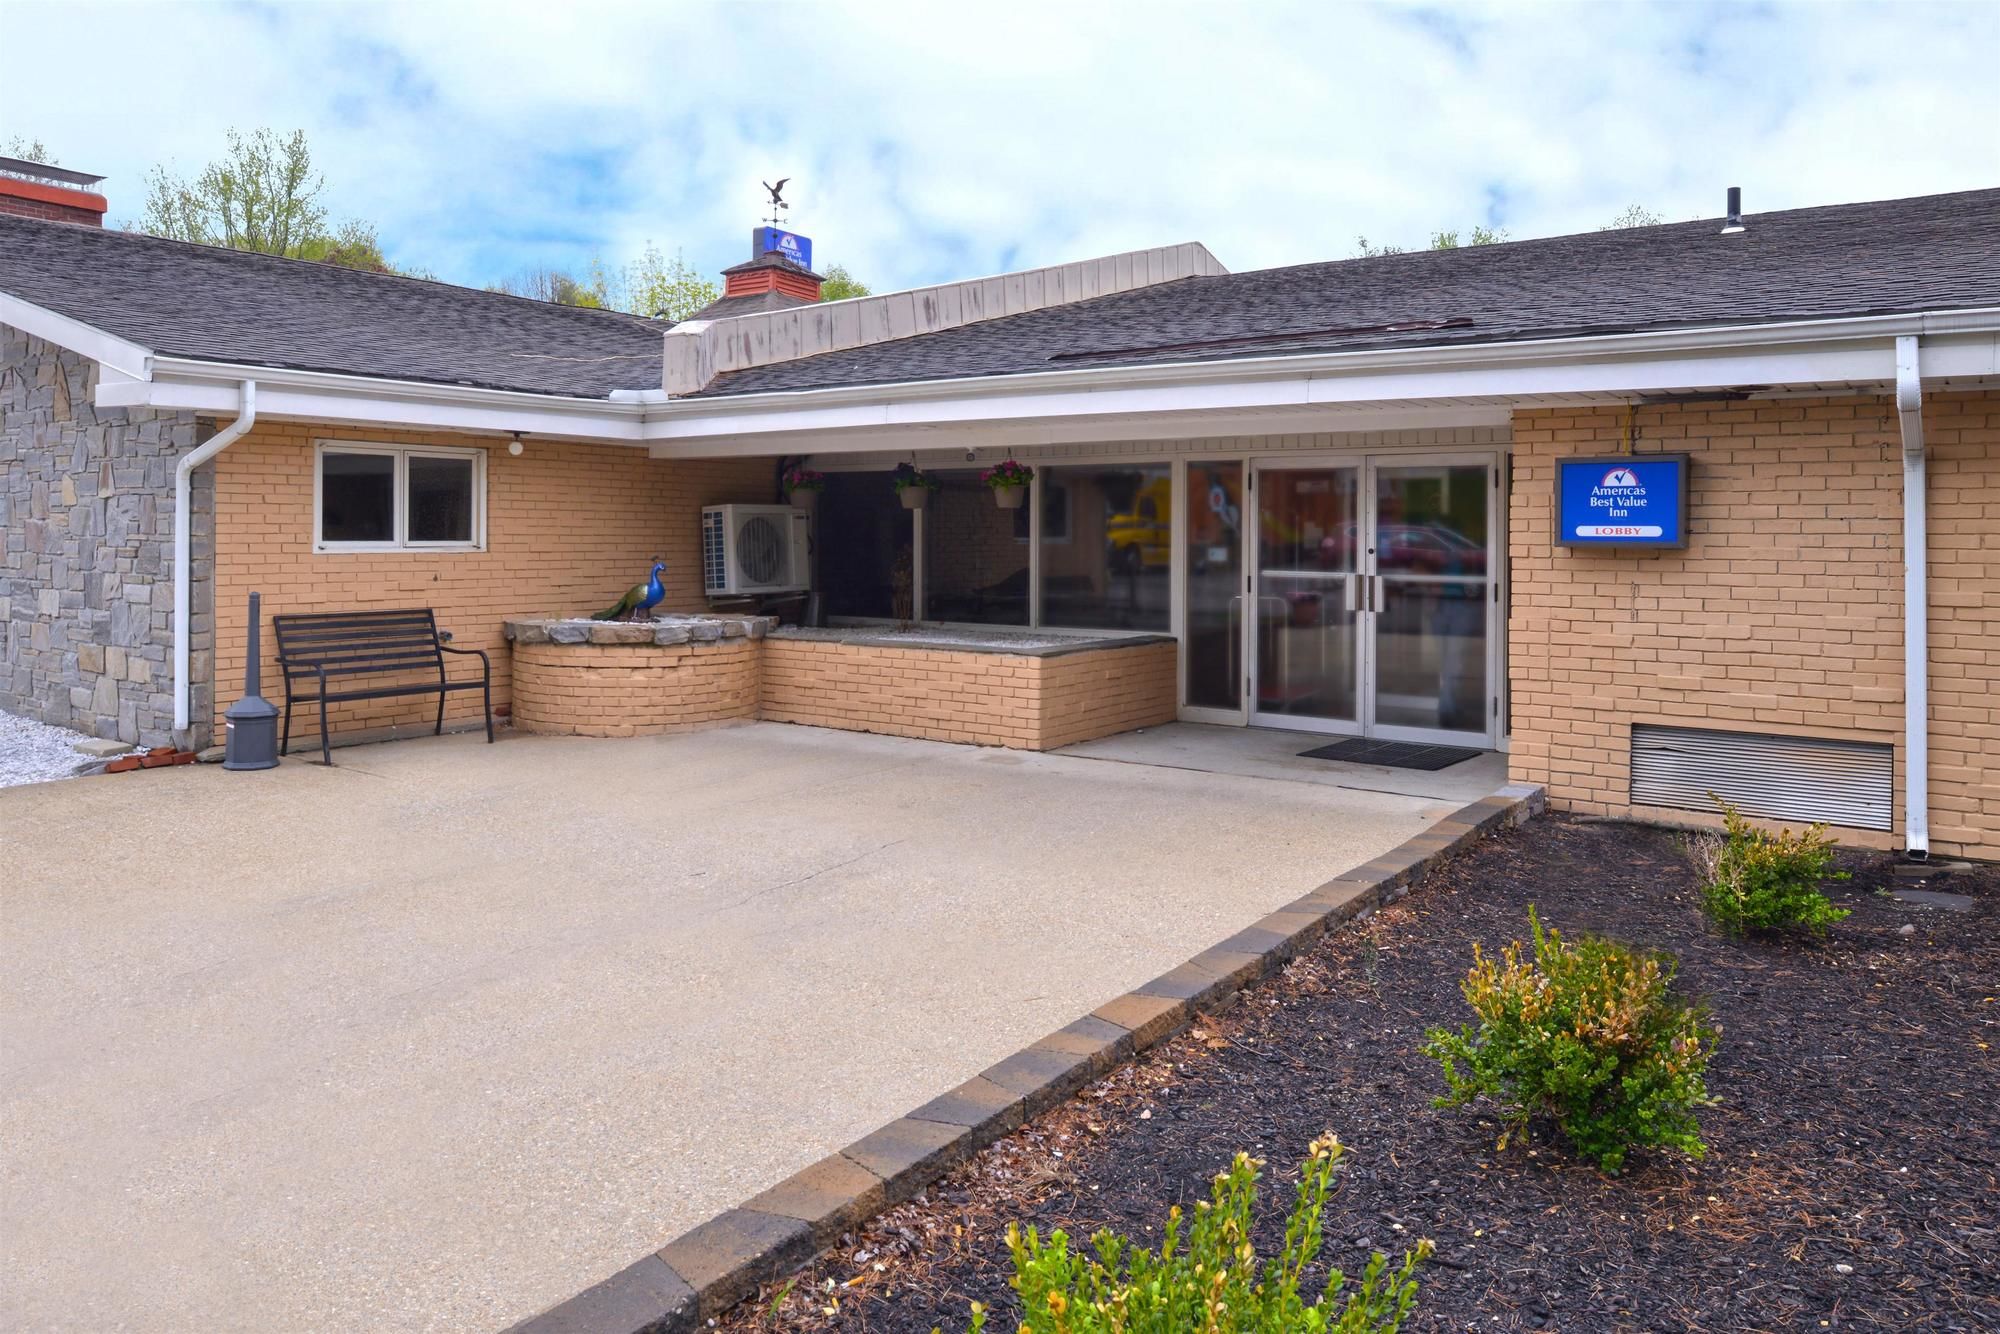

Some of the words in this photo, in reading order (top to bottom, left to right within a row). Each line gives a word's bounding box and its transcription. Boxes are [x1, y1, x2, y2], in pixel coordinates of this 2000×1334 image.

[1591, 485, 1647, 496] Americas
[1590, 496, 1614, 507] Best
[1616, 496, 1648, 507] Value
[1609, 507, 1628, 517] Inn
[1595, 527, 1642, 535] LOBBY
